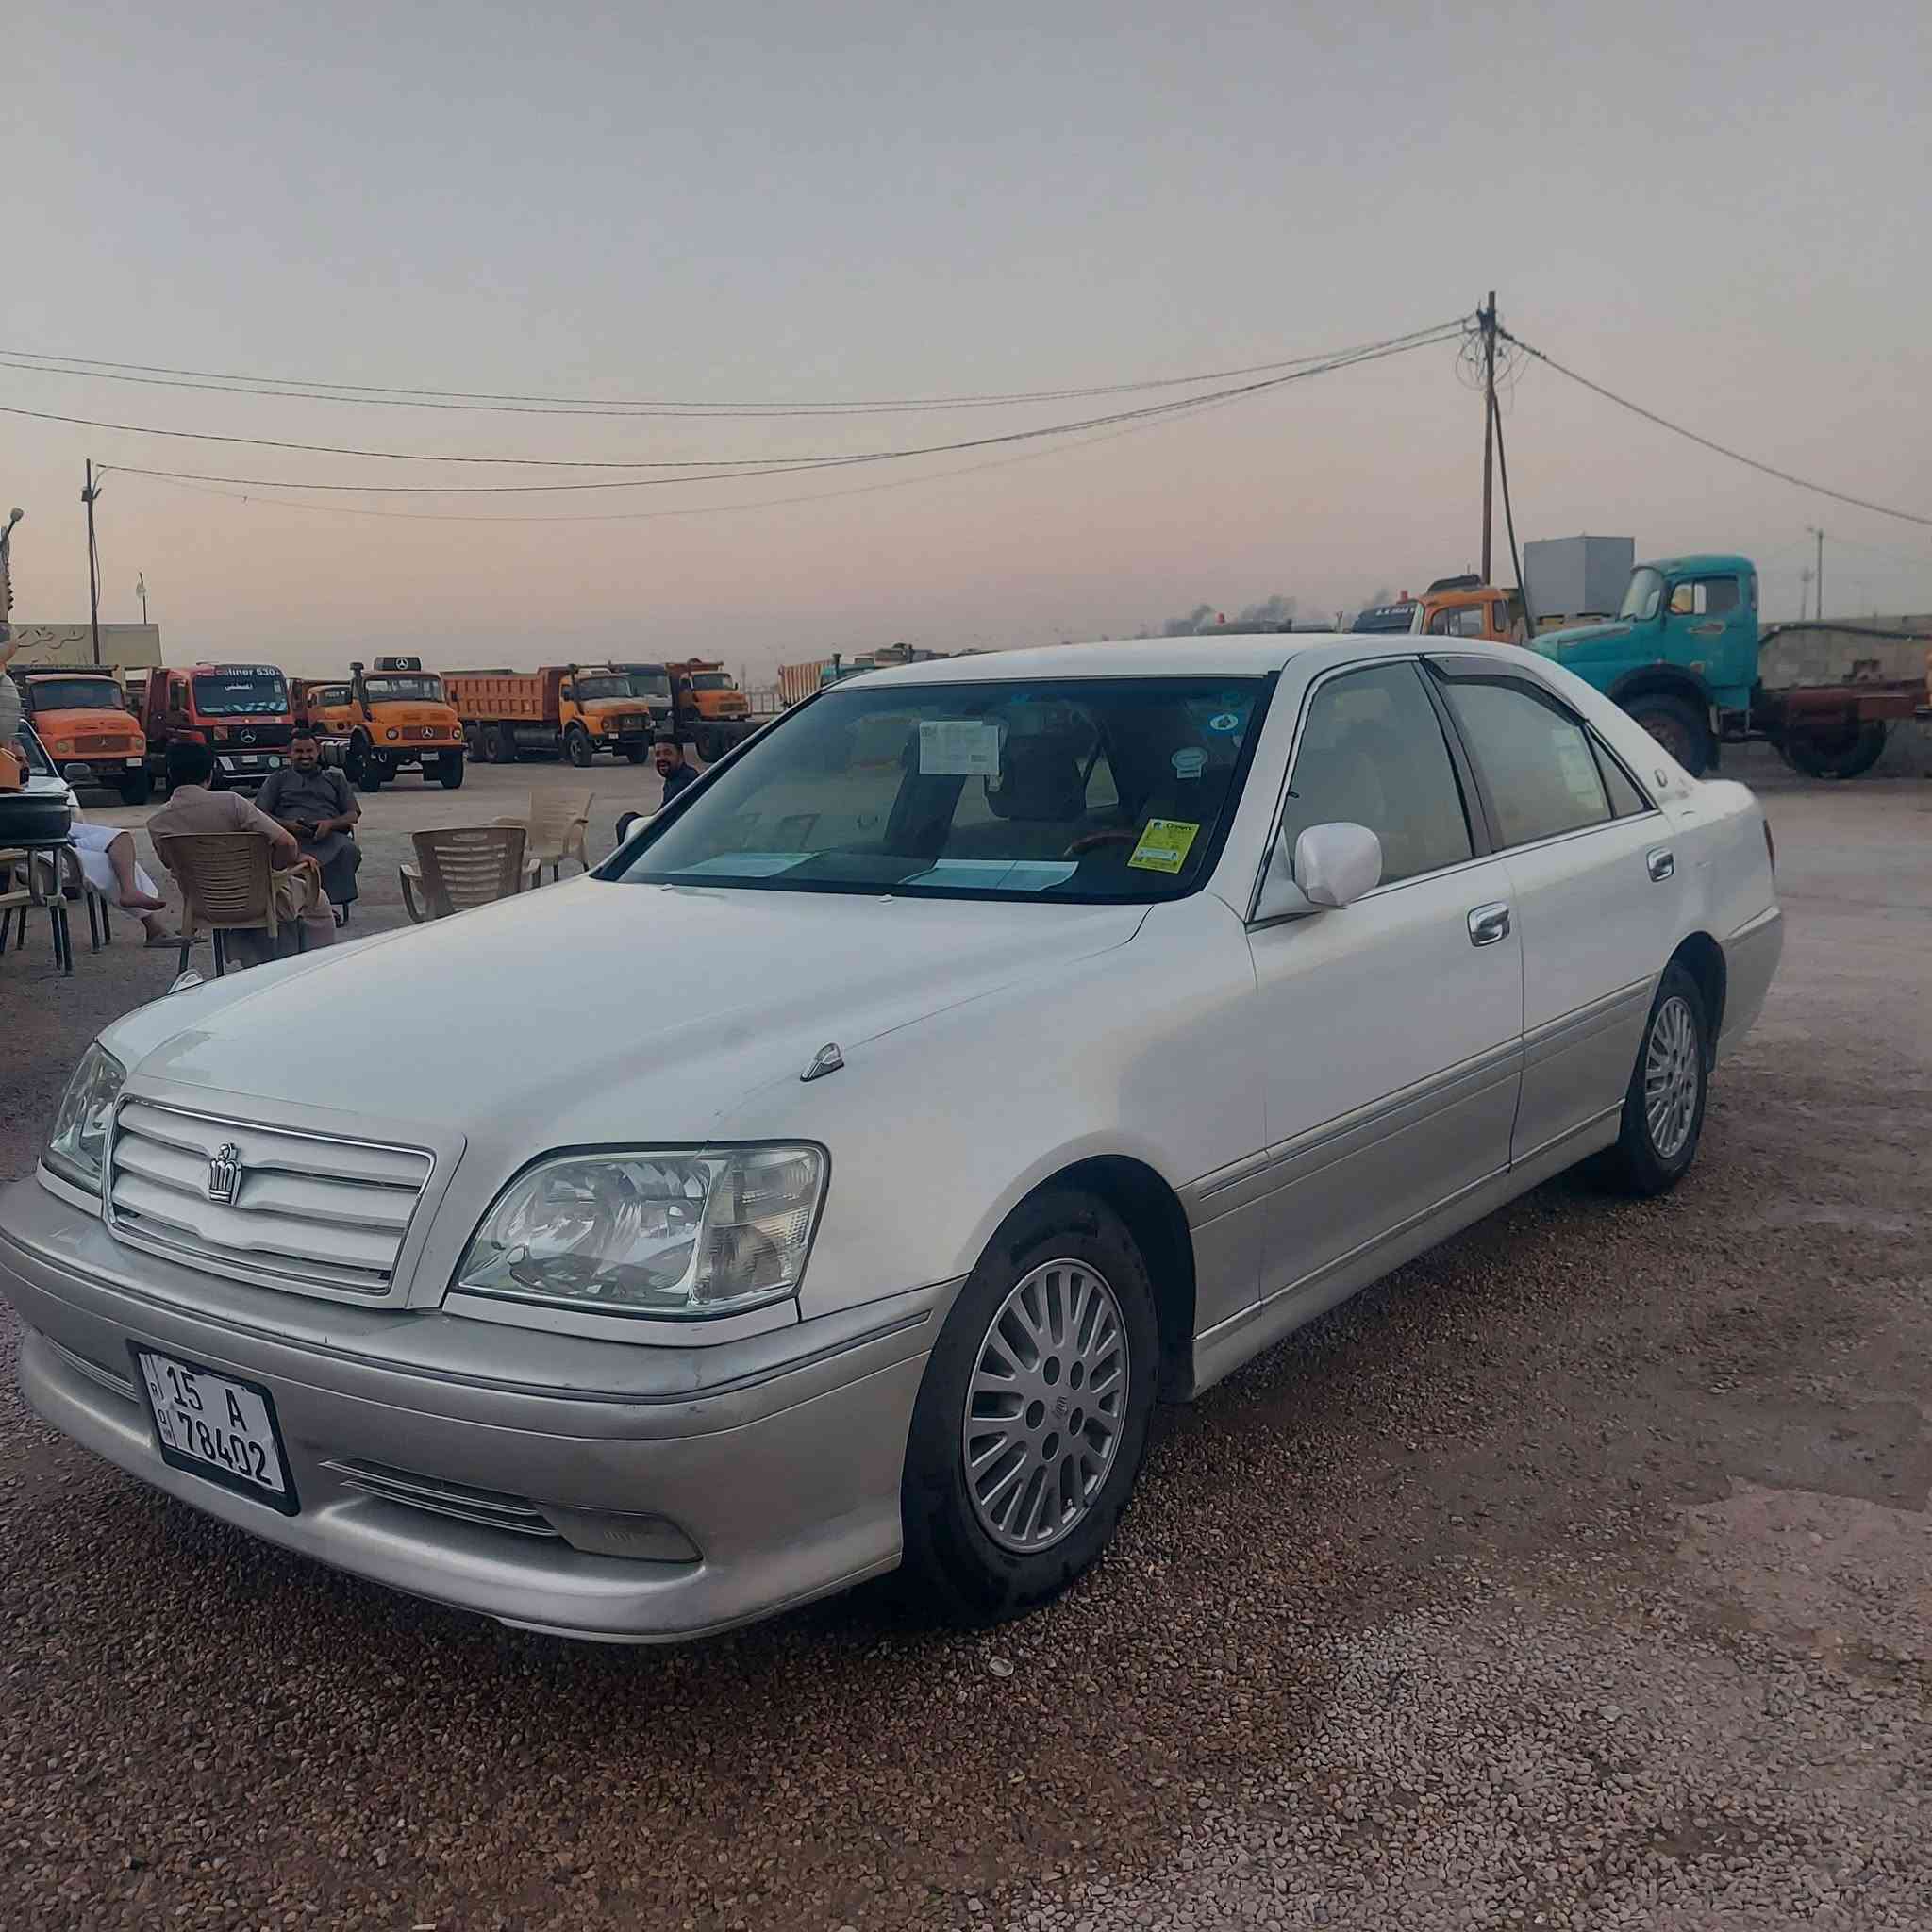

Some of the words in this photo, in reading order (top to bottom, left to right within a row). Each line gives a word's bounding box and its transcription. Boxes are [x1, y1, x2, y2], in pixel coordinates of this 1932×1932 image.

[167, 1365, 204, 1411] 15
[225, 1388, 247, 1432] A
[177, 1410, 273, 1486] 78402
